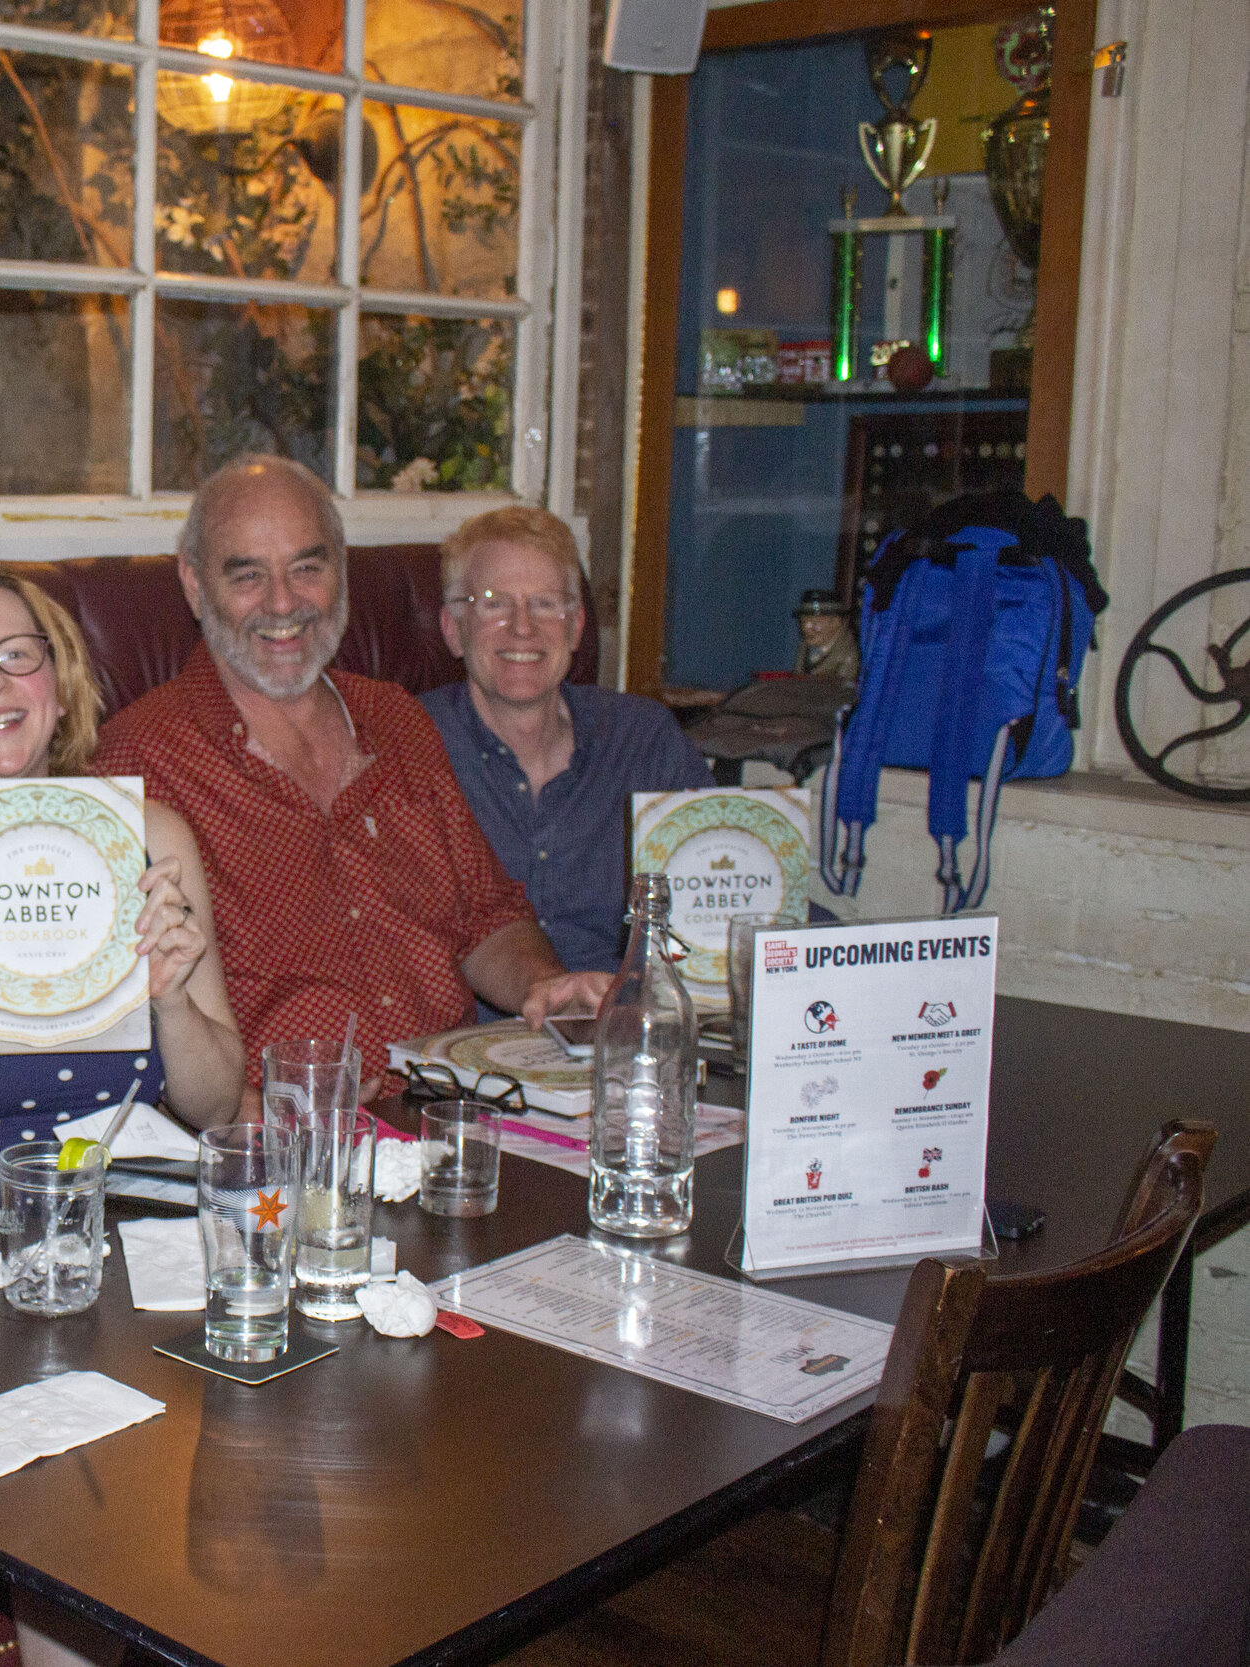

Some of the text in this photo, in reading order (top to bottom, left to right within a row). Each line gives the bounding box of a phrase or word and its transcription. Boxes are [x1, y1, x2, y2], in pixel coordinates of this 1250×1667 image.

[673, 874, 772, 891] DOWNTON
[693, 893, 752, 909] ABBEY
[4, 904, 77, 923] ABBEY
[765, 941, 786, 950] SAINT
[805, 935, 991, 969] UPCOMING EVENTS
[765, 957, 794, 966] SOCIETY
[782, 965, 798, 973] YORK
[908, 1033, 936, 1041] MEMBER
[937, 1031, 953, 1039] MEET
[961, 1028, 981, 1036] GREET
[797, 1041, 817, 1050] TASTE
[827, 1039, 847, 1047] HOME
[894, 1102, 971, 1115] REMEMBRANCE SUNDAY
[790, 1113, 840, 1124] BONFIRE NIGHT
[905, 1183, 949, 1193] BRITISH BASH
[773, 1198, 794, 1206] GREAT
[796, 1195, 822, 1204] BRITISH
[837, 1192, 853, 1200] QUIZ
[770, 1344, 815, 1365] MENU
